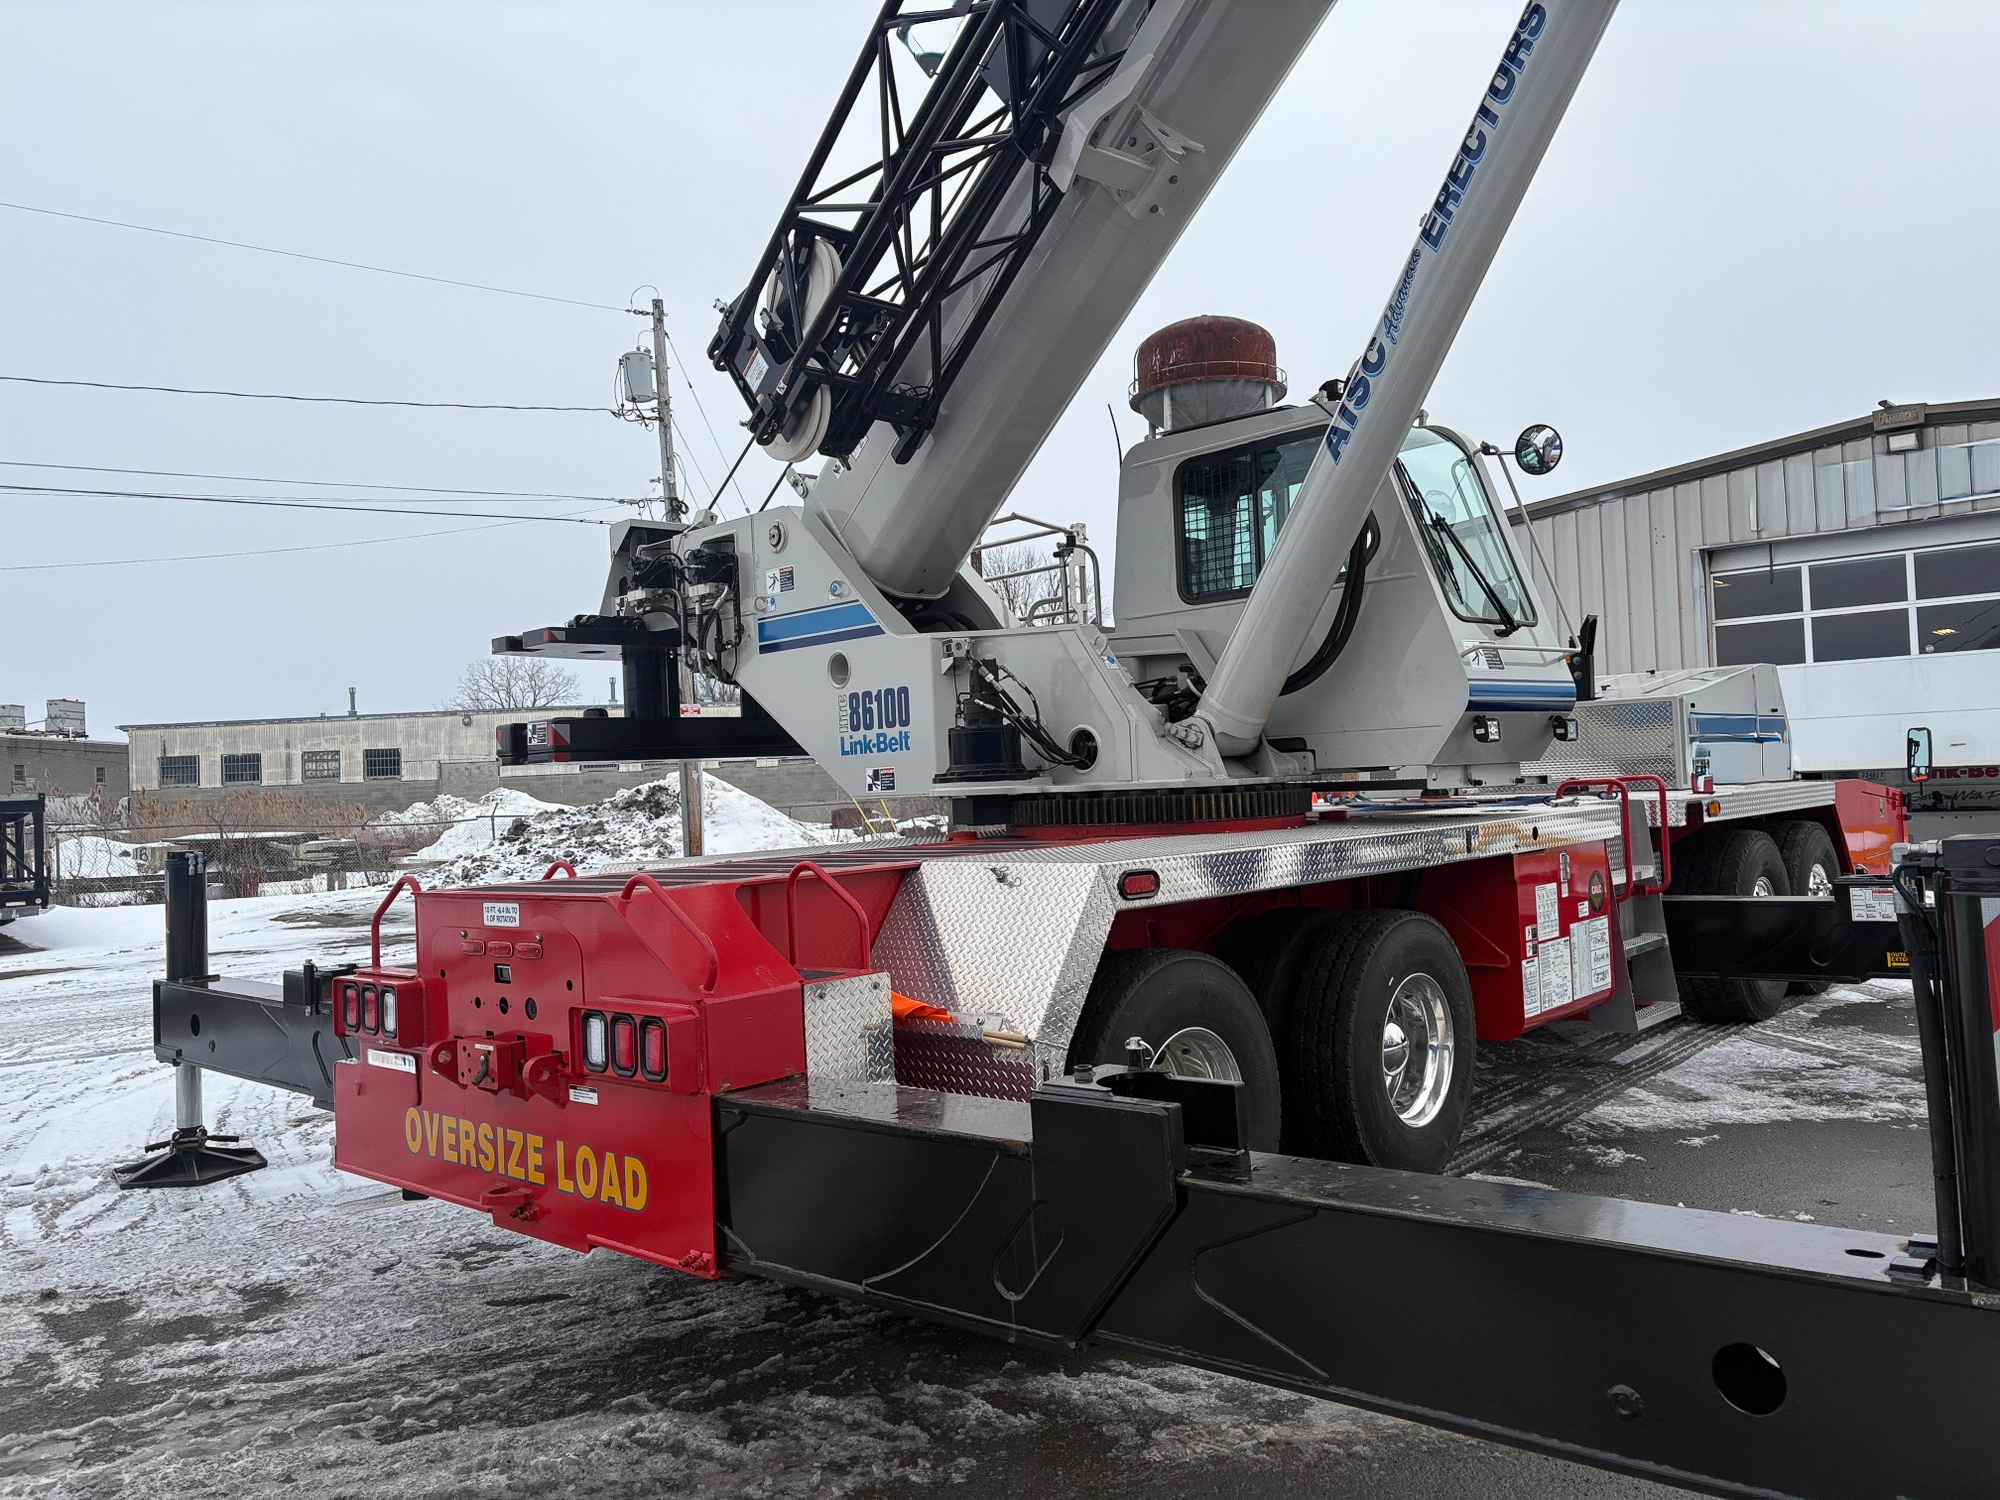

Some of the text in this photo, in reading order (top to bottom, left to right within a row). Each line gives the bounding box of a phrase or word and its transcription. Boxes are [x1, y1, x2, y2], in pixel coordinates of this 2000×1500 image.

[1326, 336, 1387, 466] AISC
[1420, 0, 1548, 254] ERECTORS
[848, 686, 911, 732] 86100
[405, 1107, 648, 1212] OVERSIZE LOAD
